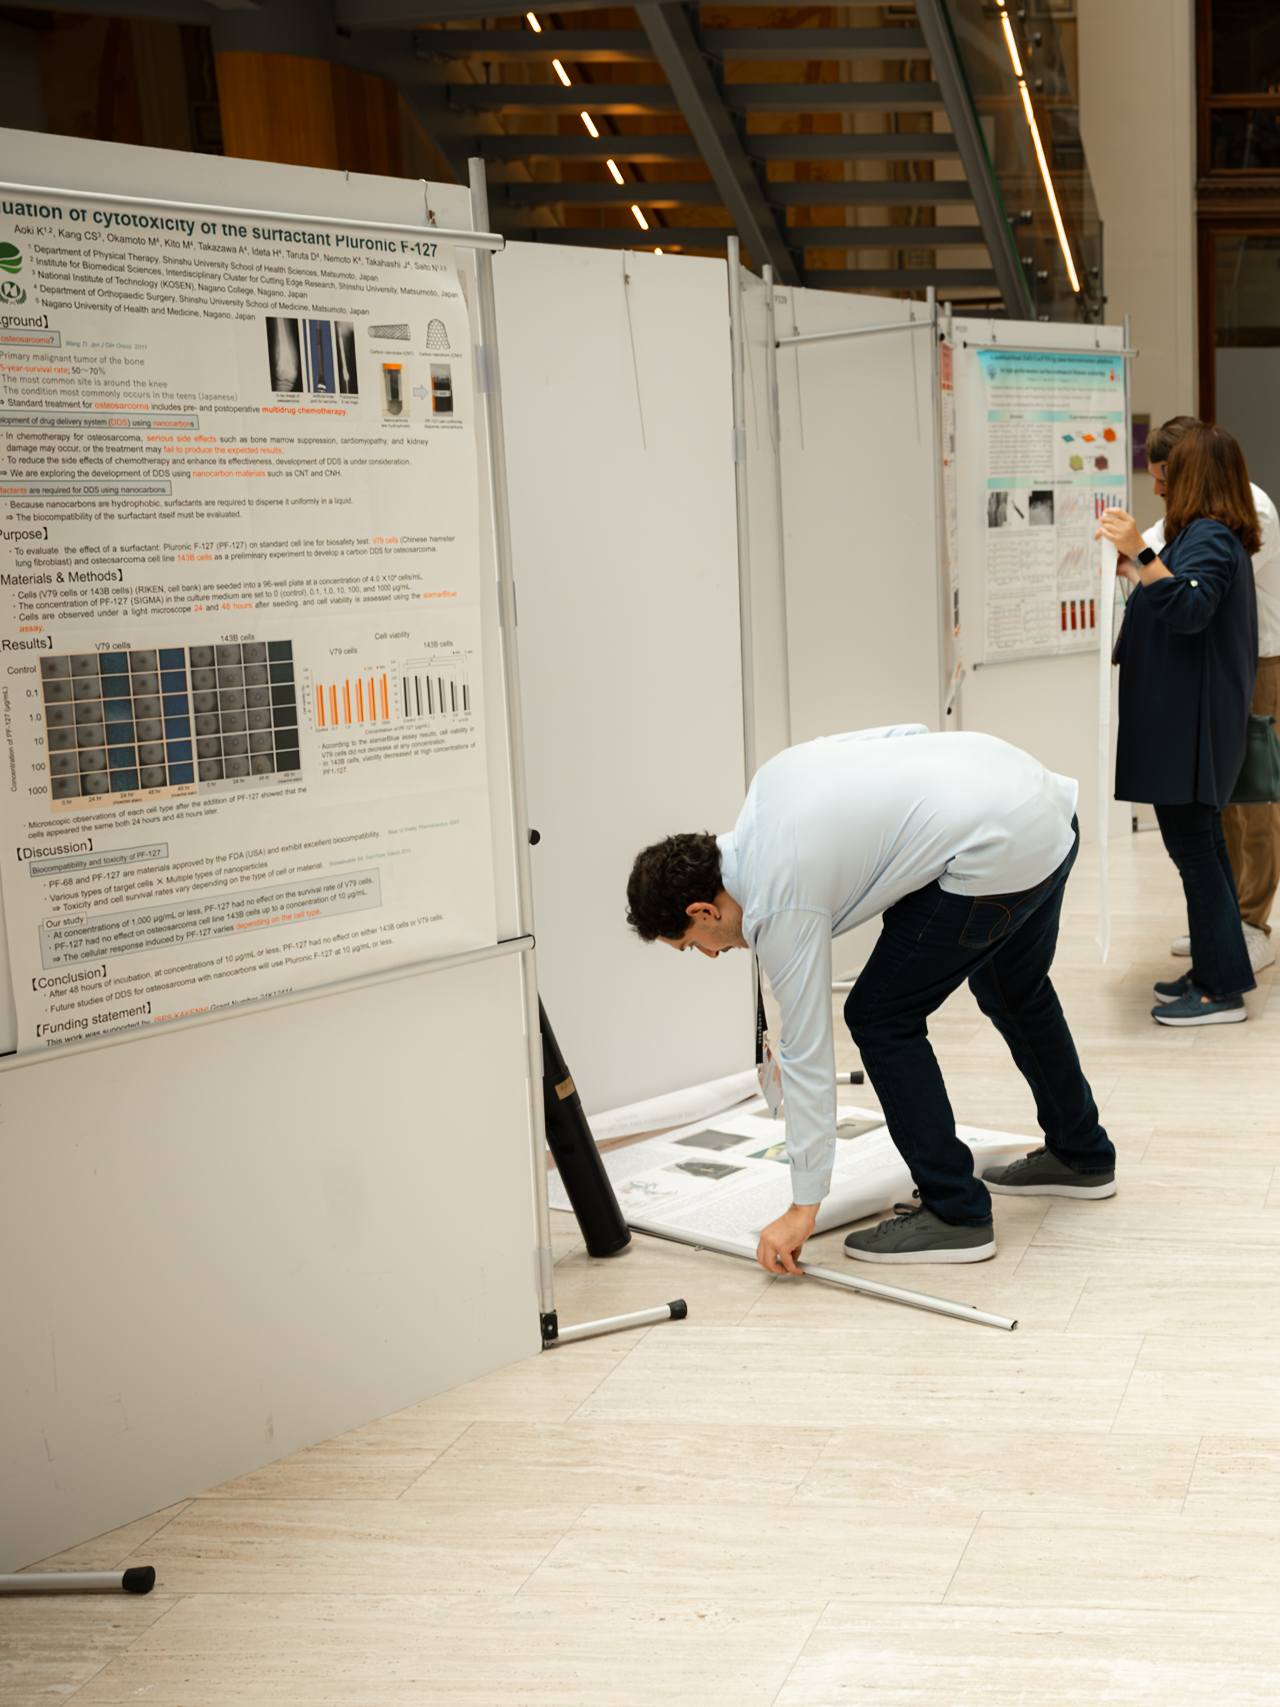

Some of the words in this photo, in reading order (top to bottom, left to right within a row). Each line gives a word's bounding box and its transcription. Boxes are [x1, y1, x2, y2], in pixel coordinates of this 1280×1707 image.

[401, 240, 437, 257] F-127
[34, 245, 81, 257] Department
[84, 249, 91, 257] of
[93, 250, 125, 262] Physical
[128, 253, 160, 264] Therapy,
[163, 256, 192, 266] Shinshu
[194, 259, 228, 271] University
[231, 262, 253, 270] School
[264, 265, 285, 274] Health
[288, 266, 319, 277] Sciences,
[321, 270, 357, 280] Matsumoto,
[359, 274, 378, 283] Japan
[0, 314, 48, 329] ground】
[2, 374, 17, 382] The
[20, 376, 39, 384] most
[78, 377, 92, 385] site
[95, 377, 100, 385] is
[104, 378, 130, 386] around
[134, 379, 146, 387] the
[149, 380, 167, 388] knee
[42, 486, 70, 496] required
[72, 486, 81, 494] for
[84, 486, 99, 494] DDS
[101, 487, 118, 496] using
[121, 486, 166, 494] nanocarbons
[1, 573, 52, 586] Materials
[56, 572, 65, 583] &
[240, 633, 255, 641] cells
[374, 632, 388, 640] Cell
[390, 631, 410, 640] viability
[7, 666, 36, 674] Control
[32, 861, 87, 875] Biocompatibility
[103, 854, 127, 866] toxicity
[129, 853, 136, 861] of
[137, 849, 161, 859] PF-127
[46, 920, 61, 929] Our
[64, 916, 84, 927] study
